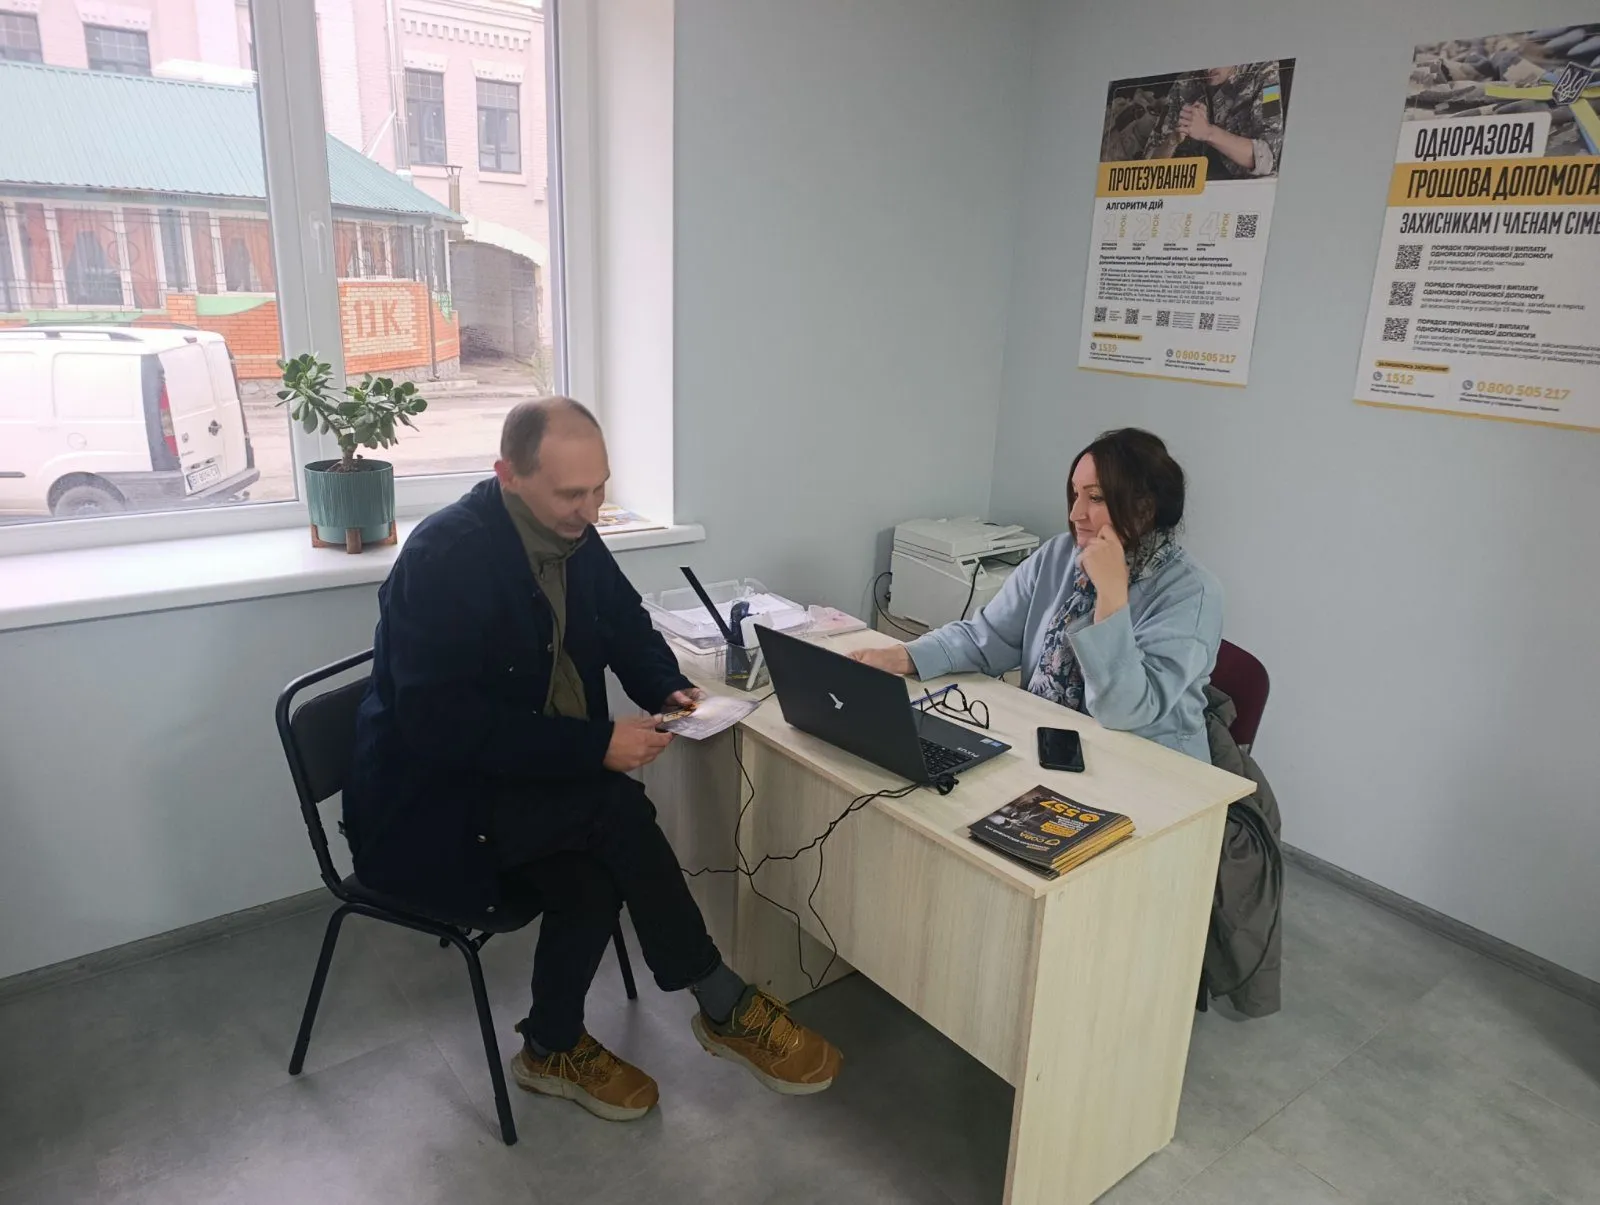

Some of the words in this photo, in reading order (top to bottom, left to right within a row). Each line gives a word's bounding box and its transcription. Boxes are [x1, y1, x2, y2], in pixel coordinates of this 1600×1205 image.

[1414, 122, 1534, 161] ОДНОРАЗОВА
[1108, 163, 1198, 191] ПРОТЕЗУВАННЯ
[1407, 167, 1491, 199] ГРОШОВА
[1492, 164, 1600, 201] ДОПОМОГА
[1106, 201, 1147, 210] АЛГОРИТМ
[1148, 199, 1164, 210] ДІЙ
[1151, 213, 1160, 238] КРОК
[1183, 213, 1193, 238] КРОК
[1198, 212, 1220, 241] 4
[1220, 213, 1230, 238] КРОК
[1400, 212, 1493, 234] ЗАХИСНИКАМ
[1493, 213, 1500, 234] І
[1503, 211, 1564, 234] ЧЛЕНАМ
[1182, 350, 1200, 361] 800
[1201, 351, 1218, 363] 505
[1218, 353, 1237, 364] 217
[1385, 372, 1415, 385] 1512
[1476, 381, 1485, 392] 0
[1486, 382, 1513, 396] 800
[1517, 384, 1542, 398] 505
[1544, 387, 1571, 400] 217
[1039, 800, 1080, 818] 557
